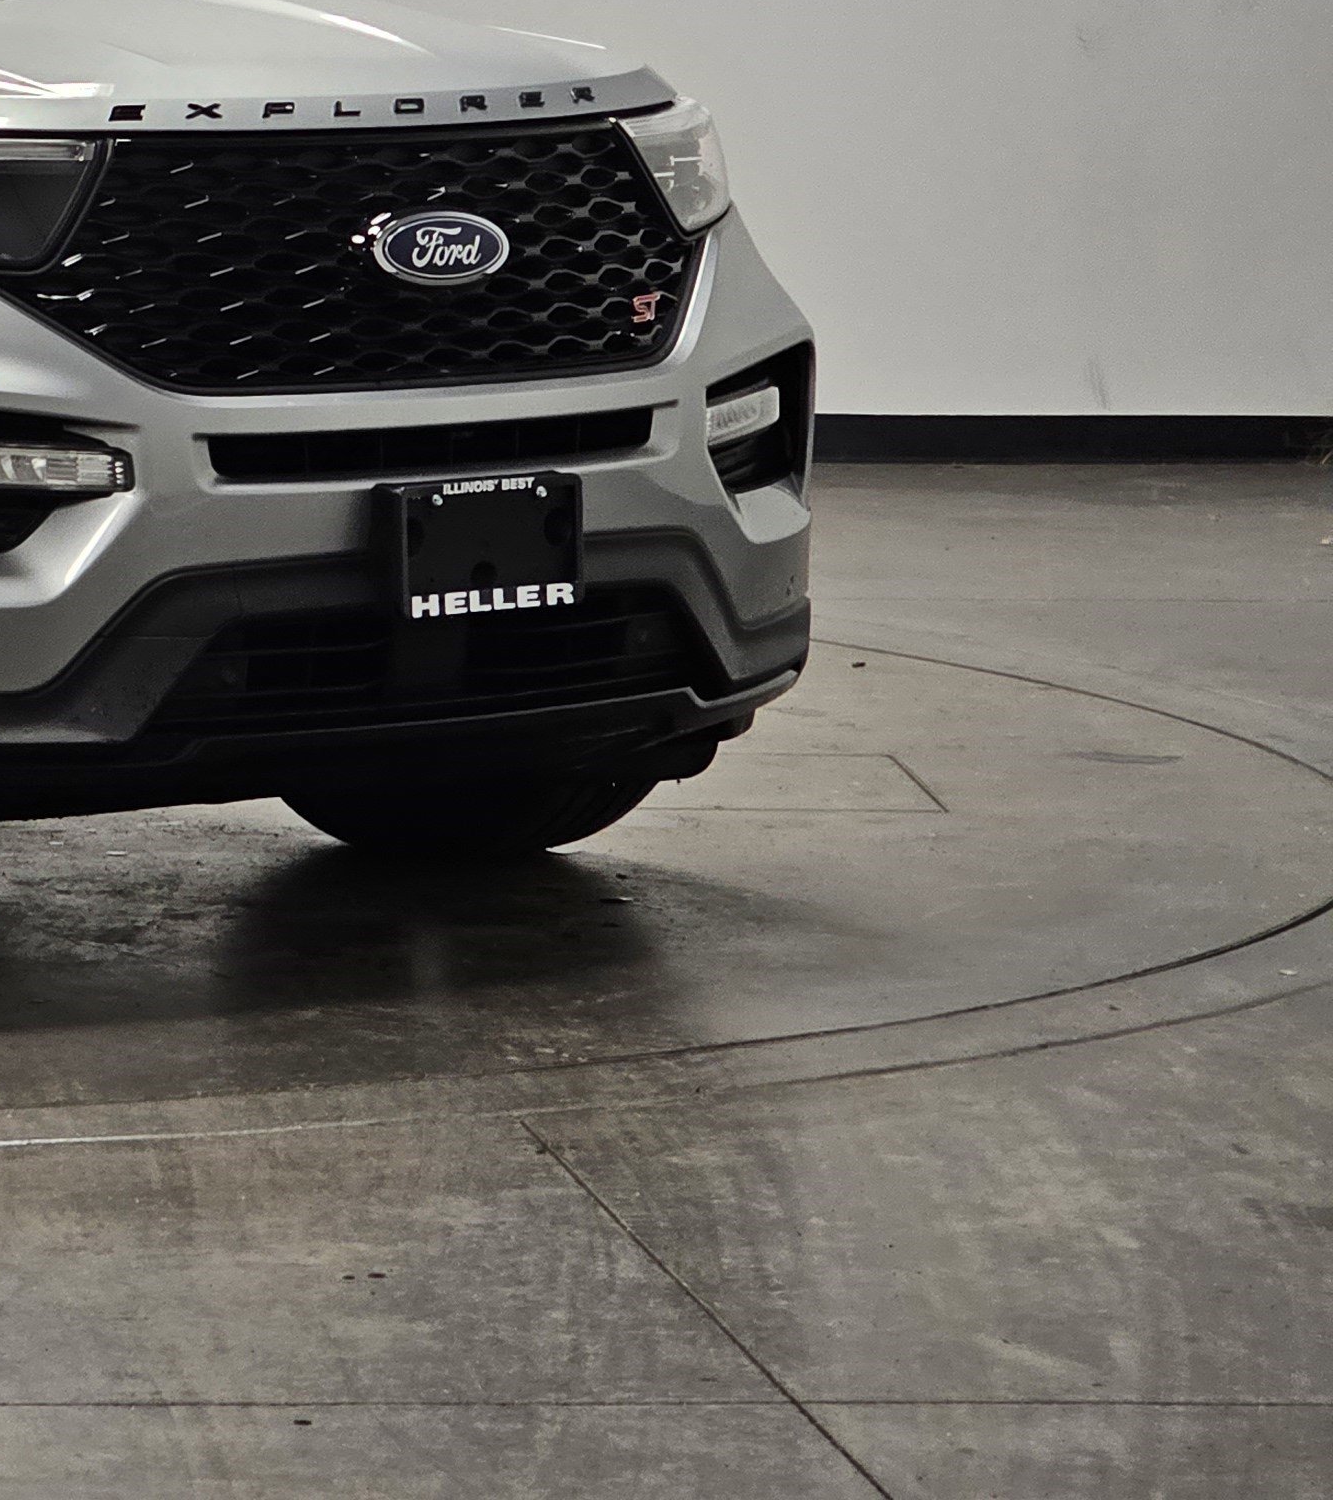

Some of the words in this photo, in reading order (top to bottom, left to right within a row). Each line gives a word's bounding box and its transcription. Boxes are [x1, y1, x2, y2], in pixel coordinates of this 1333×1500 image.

[108, 85, 597, 122] EXPLORER
[411, 226, 482, 268] Ford
[631, 291, 661, 324] ST
[501, 476, 535, 491] BEST
[411, 582, 575, 619] HELLER
